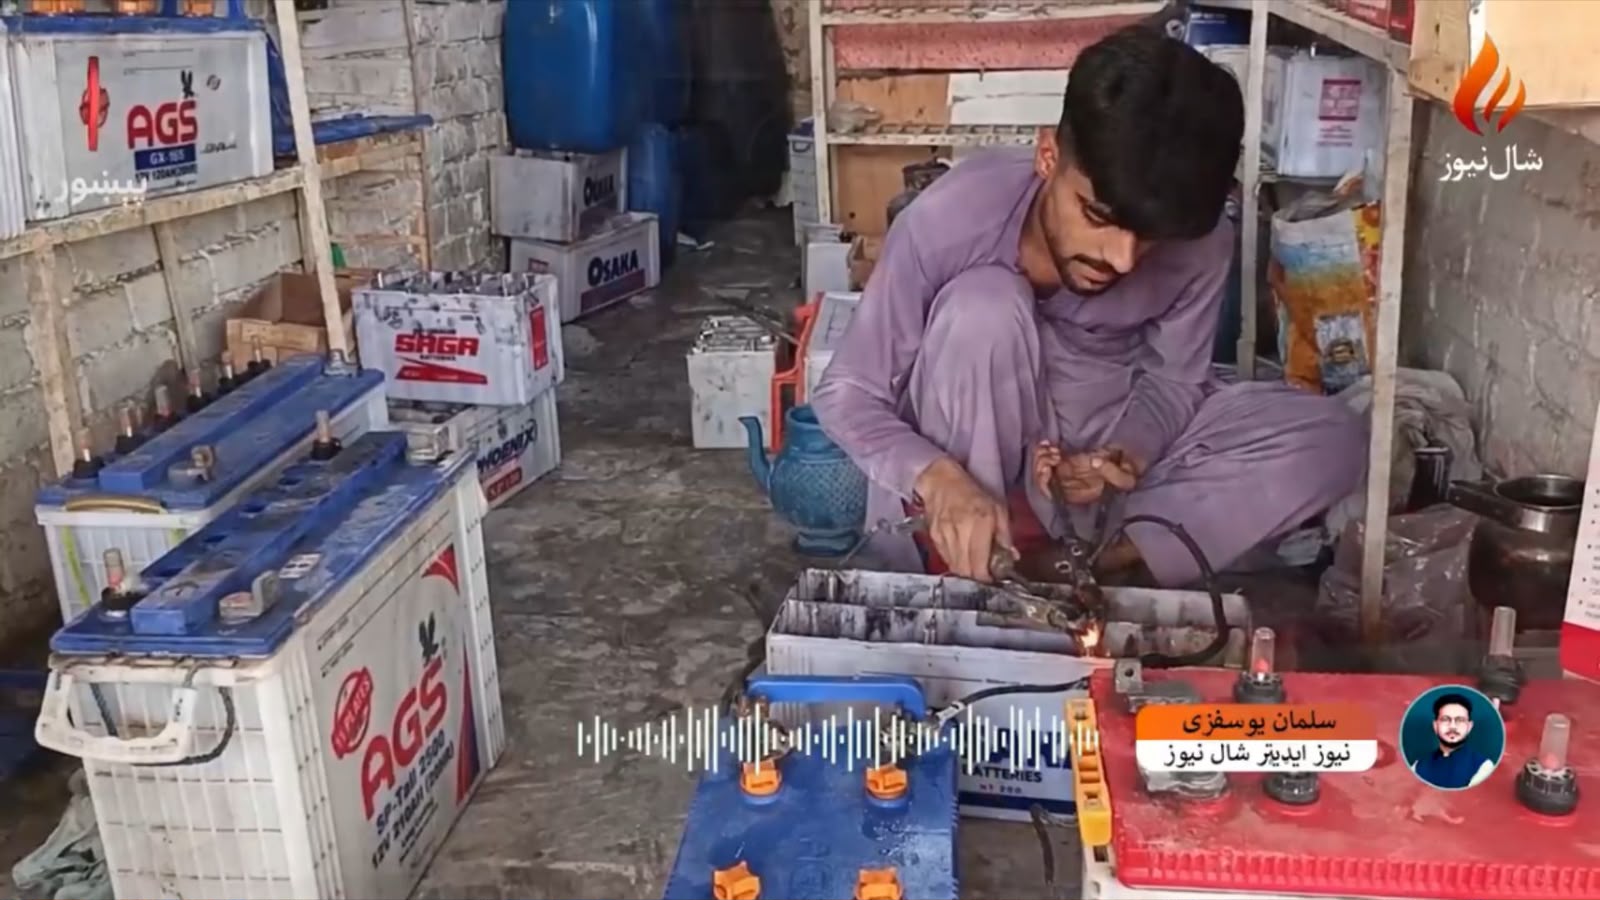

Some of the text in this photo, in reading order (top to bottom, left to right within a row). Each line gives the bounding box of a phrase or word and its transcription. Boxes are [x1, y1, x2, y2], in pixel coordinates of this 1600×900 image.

[126, 99, 199, 150] AGS
[587, 248, 640, 288] OSAKA
[394, 333, 480, 357] SAGA
[361, 655, 447, 821] AGS
